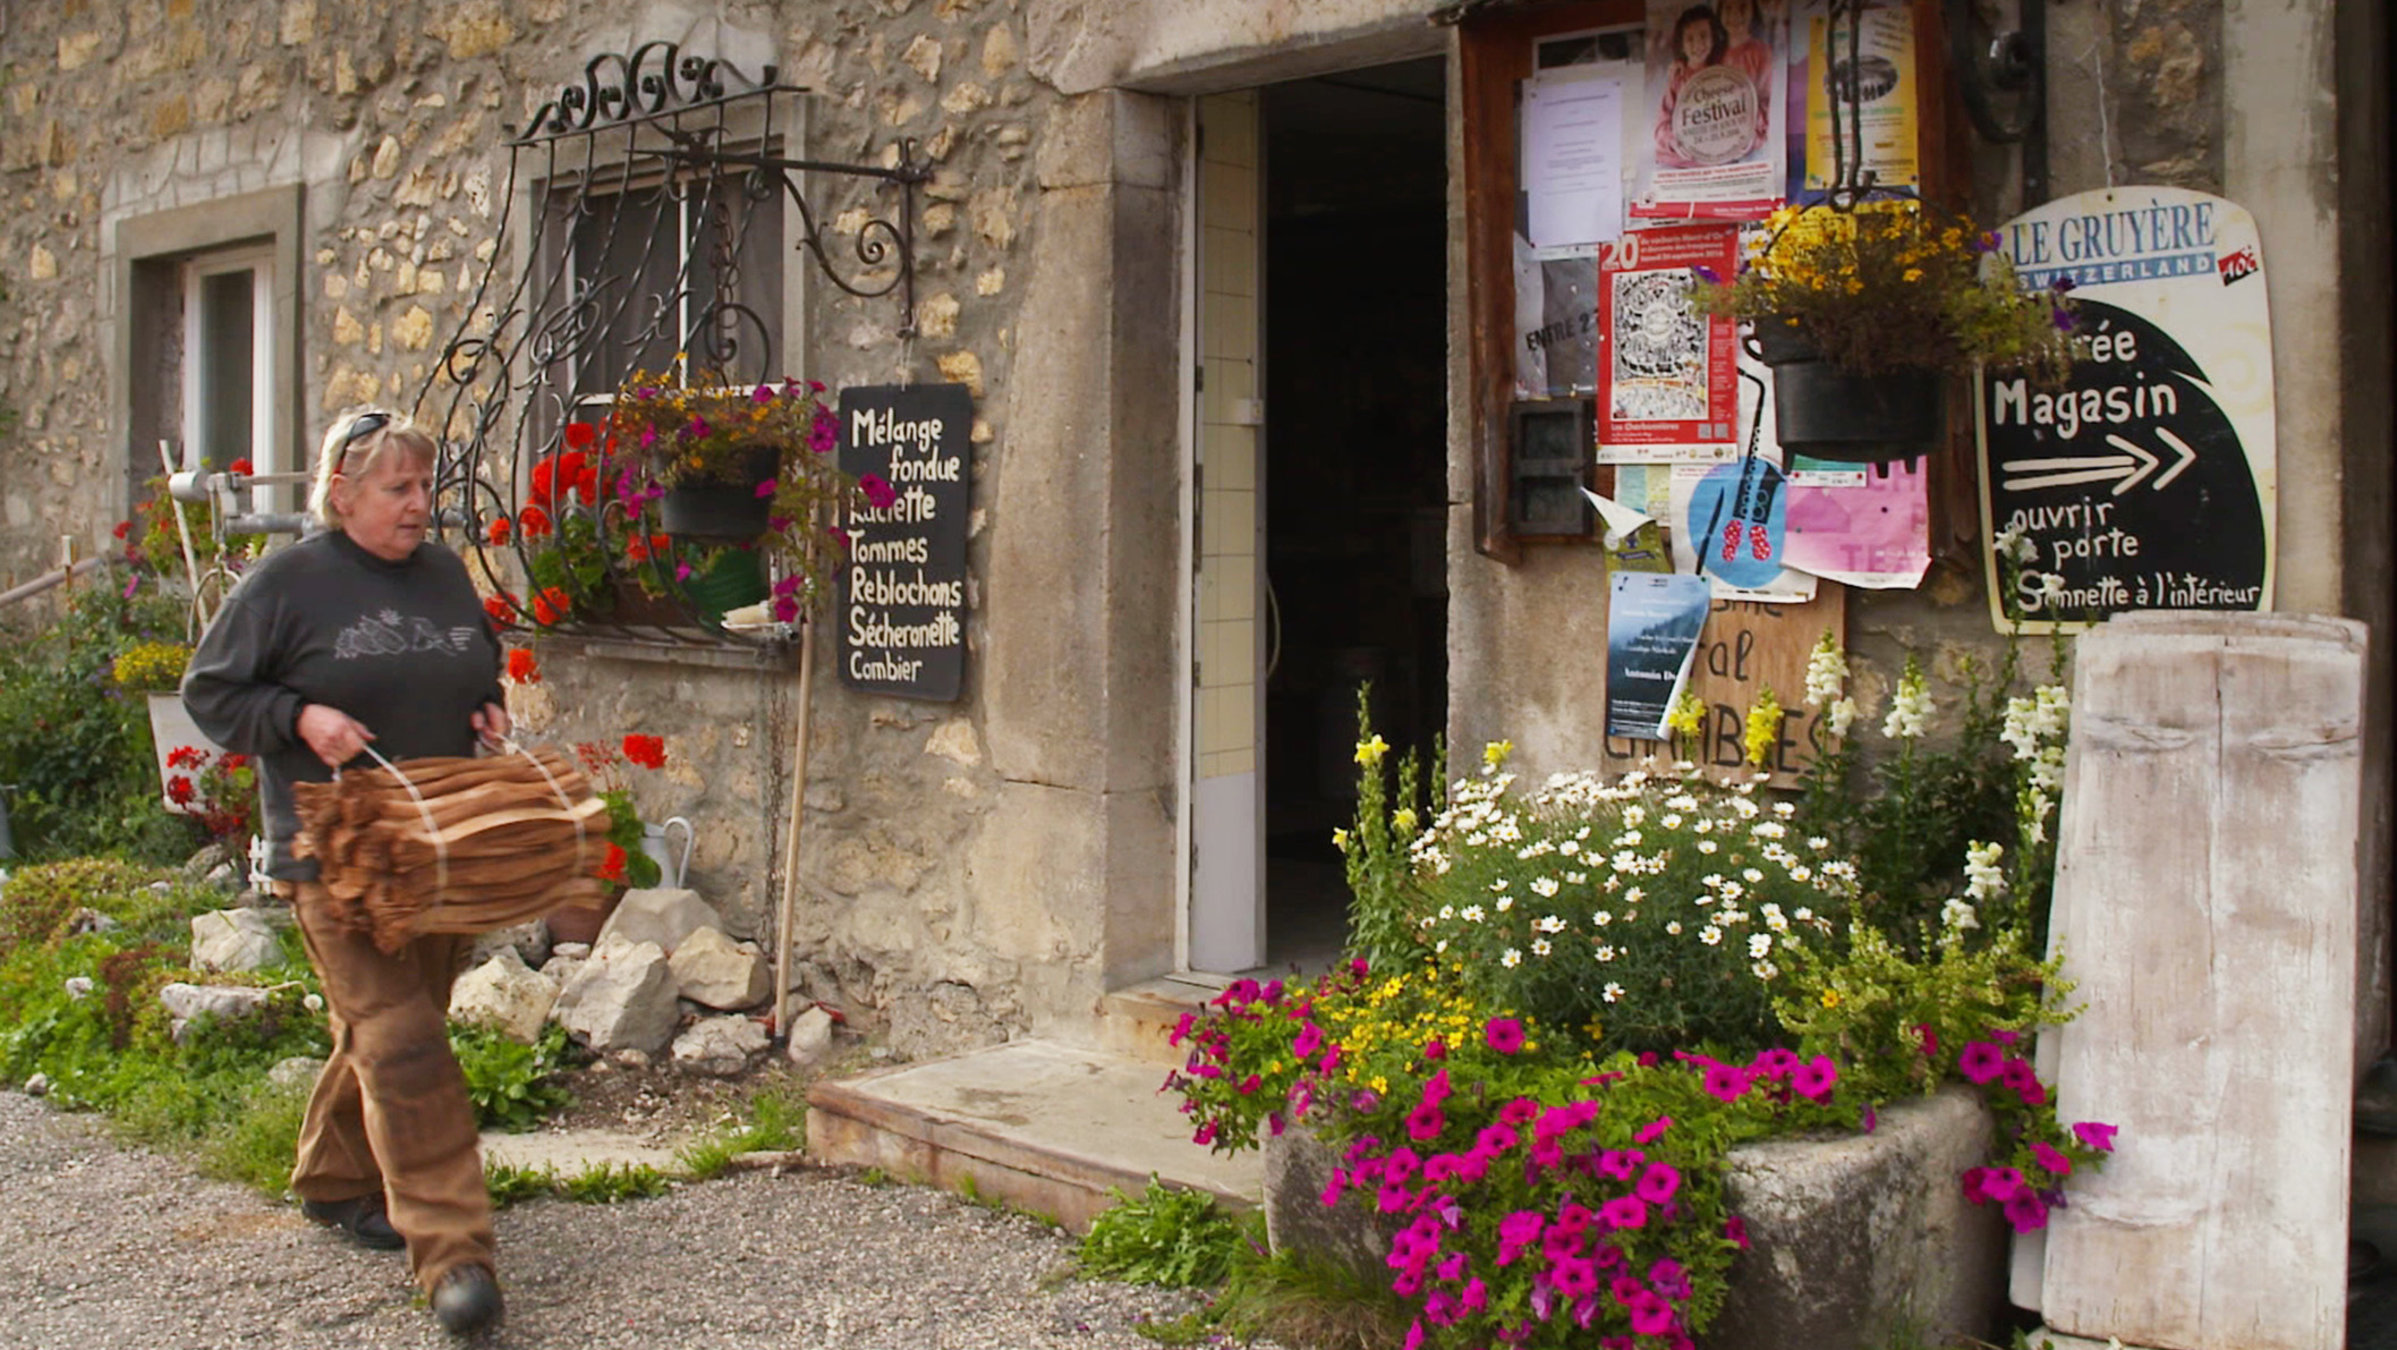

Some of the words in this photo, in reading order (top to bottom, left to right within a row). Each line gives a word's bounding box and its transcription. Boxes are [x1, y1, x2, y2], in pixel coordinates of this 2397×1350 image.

[1682, 92, 1747, 127] Festival
[2011, 220, 2051, 266] LE
[2059, 198, 2215, 263] GRUYÈRE
[1602, 233, 1640, 271] 20
[1526, 317, 1576, 352] ENTRE
[1994, 371, 2177, 440] Magasin
[851, 407, 944, 453] Mélange
[889, 444, 961, 483] fondue
[2011, 495, 2115, 534] ouvrir
[847, 529, 928, 564] Tommes
[2052, 526, 2139, 571] porte
[851, 566, 963, 608] Reblochons
[2136, 574, 2149, 606] à
[2155, 571, 2261, 607] l'intérieur
[849, 605, 961, 648] Sécheronette
[850, 651, 923, 683] Combier
